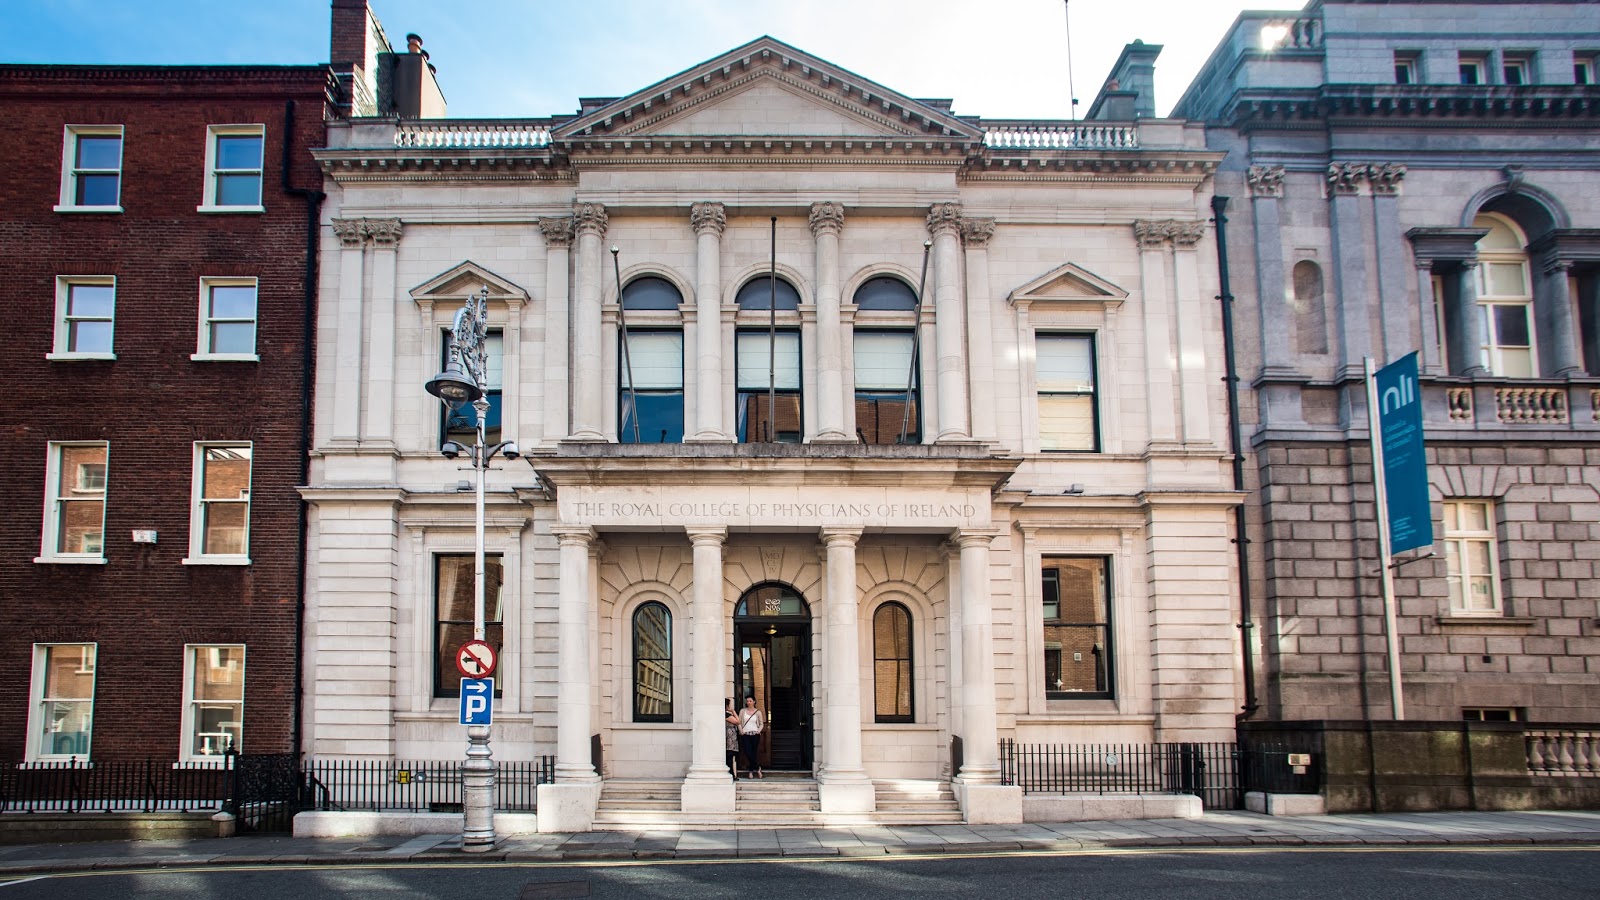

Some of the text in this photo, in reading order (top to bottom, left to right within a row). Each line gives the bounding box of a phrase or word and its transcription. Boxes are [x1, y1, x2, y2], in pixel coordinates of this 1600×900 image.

[1383, 374, 1415, 415] nli
[573, 502, 976, 518] THE ROYAL COLLEGE OF PHYSICIANS OF IRELAND
[465, 695, 487, 723] P
